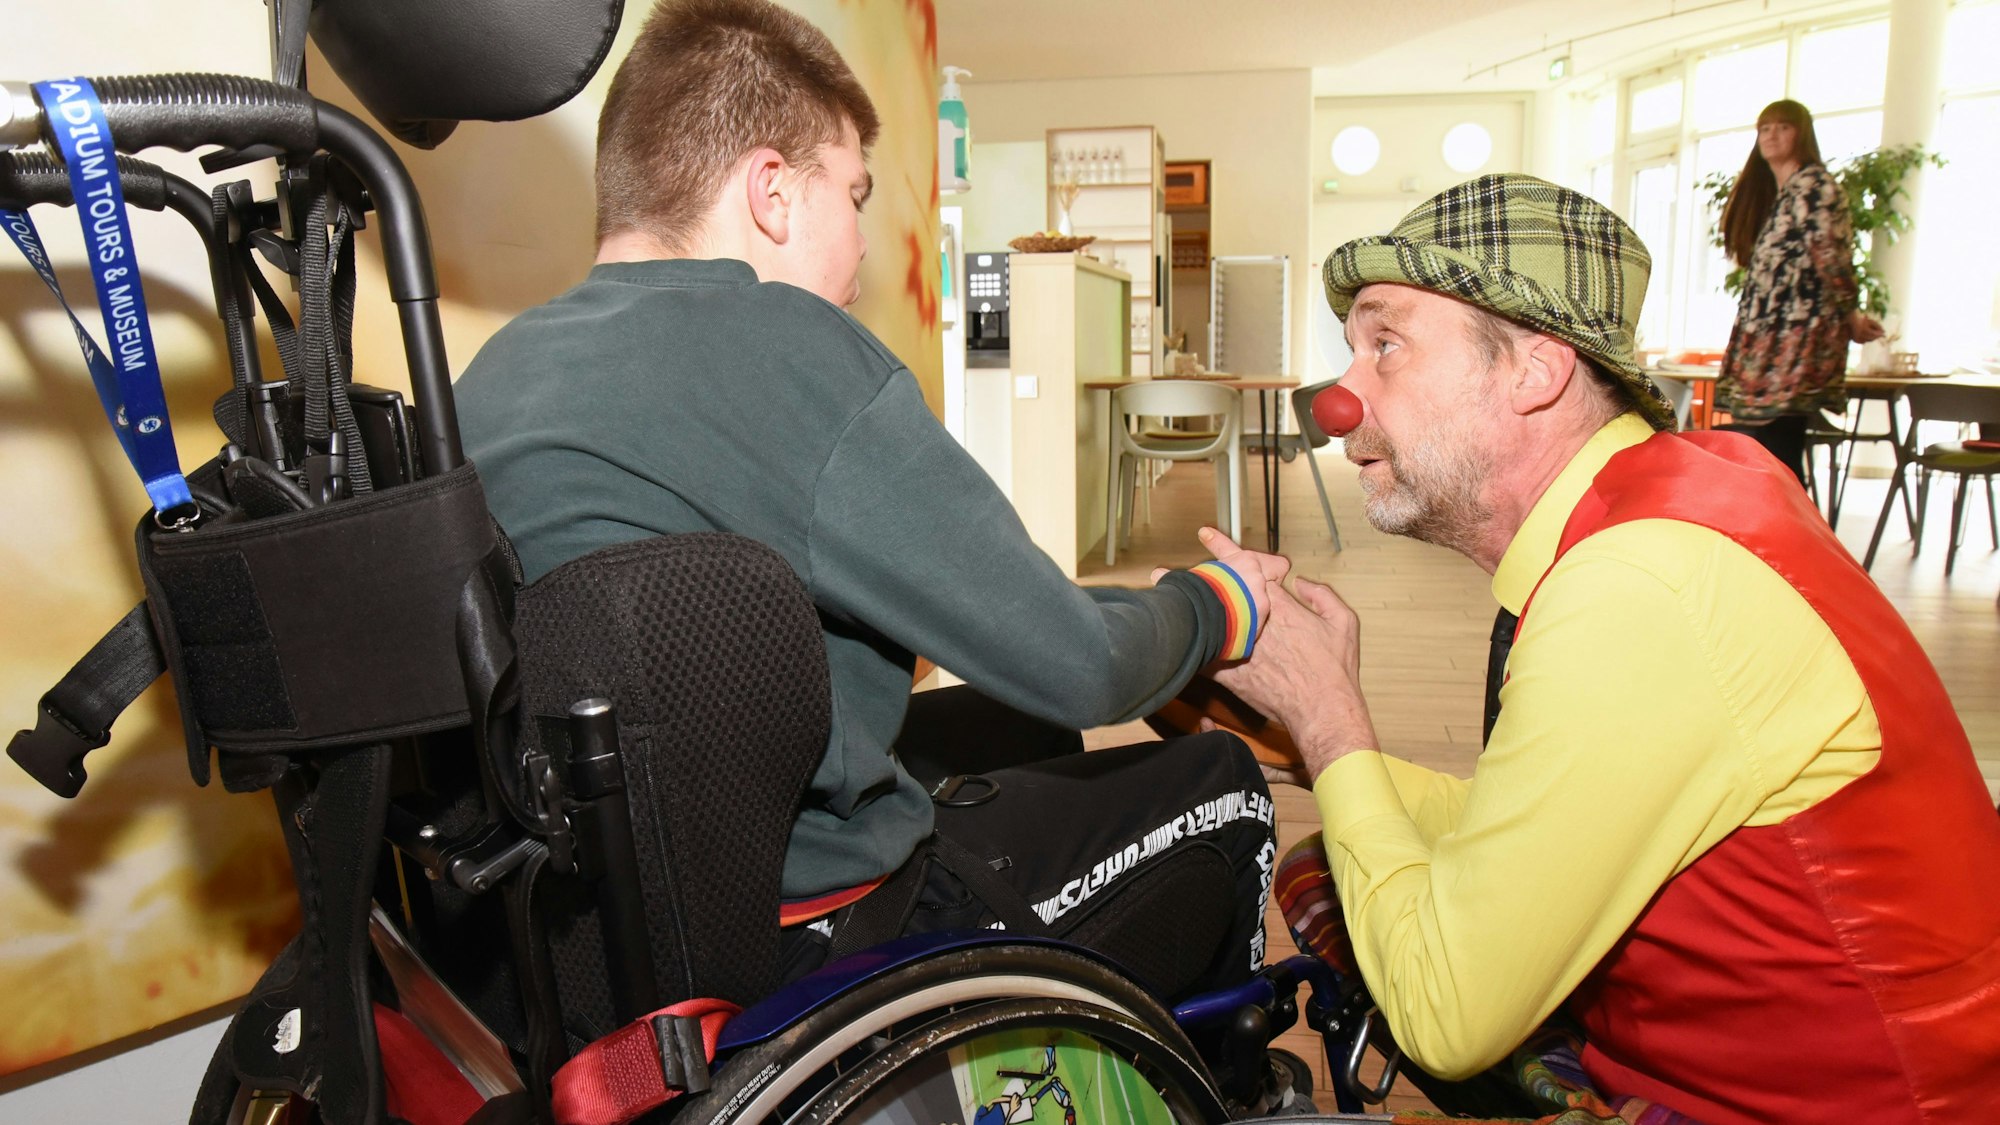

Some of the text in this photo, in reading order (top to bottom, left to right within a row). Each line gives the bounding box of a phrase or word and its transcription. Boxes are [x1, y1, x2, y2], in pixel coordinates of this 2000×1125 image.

[5, 213, 47, 270] TOURS
[48, 78, 147, 371] ADIUM TOURS & MUSEUM
[728, 1096, 738, 1107] USE
[736, 1085, 748, 1099] WITH
[747, 1073, 761, 1088] HEAVY
